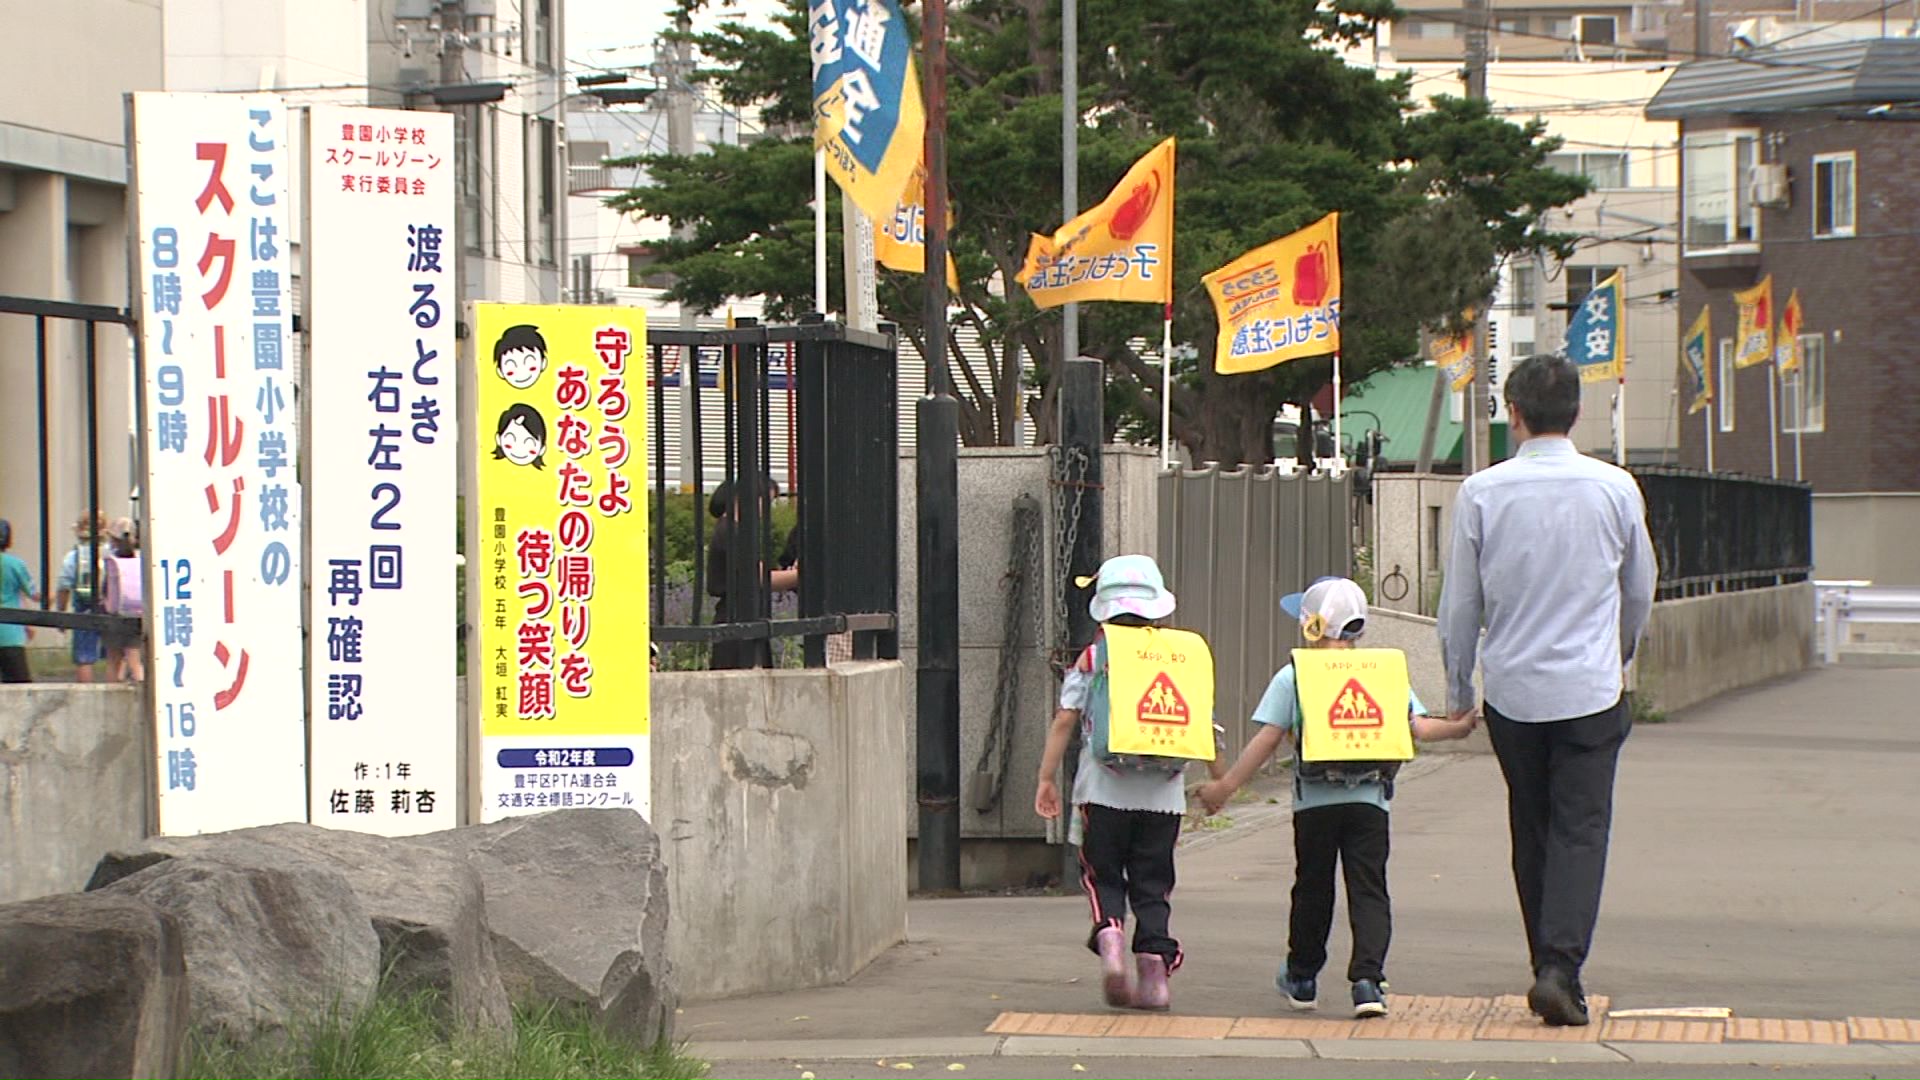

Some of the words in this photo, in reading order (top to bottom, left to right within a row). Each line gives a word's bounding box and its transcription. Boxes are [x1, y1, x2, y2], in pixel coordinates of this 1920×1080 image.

[325, 147, 442, 170] スクールゾーン
[341, 124, 426, 146] 豊園小学校
[341, 174, 426, 196] 実行委員会
[151, 226, 188, 454] 8時～9時
[248, 108, 291, 587] ここは豊園小学校の
[406, 223, 443, 445] 渡るとき
[194, 142, 250, 712] スクールゾーン
[367, 365, 403, 590] 右左2回
[594, 326, 631, 514] 守ろうよ
[493, 507, 506, 590] 豊園小学校
[555, 365, 593, 695] あなたの帰りを
[160, 558, 198, 792] 12時～16時
[327, 558, 363, 721] 再確認
[494, 598, 507, 630] 五年
[516, 529, 553, 717] 待つ笑顔
[495, 686, 509, 719] 紅実
[534, 749, 597, 767] 令和2年度
[329, 788, 376, 815] 佐藤
[390, 788, 437, 815] 莉杏
[498, 791, 635, 808] 交通安全標語コンクール
[514, 772, 618, 790] 豊平区PTA連合会
